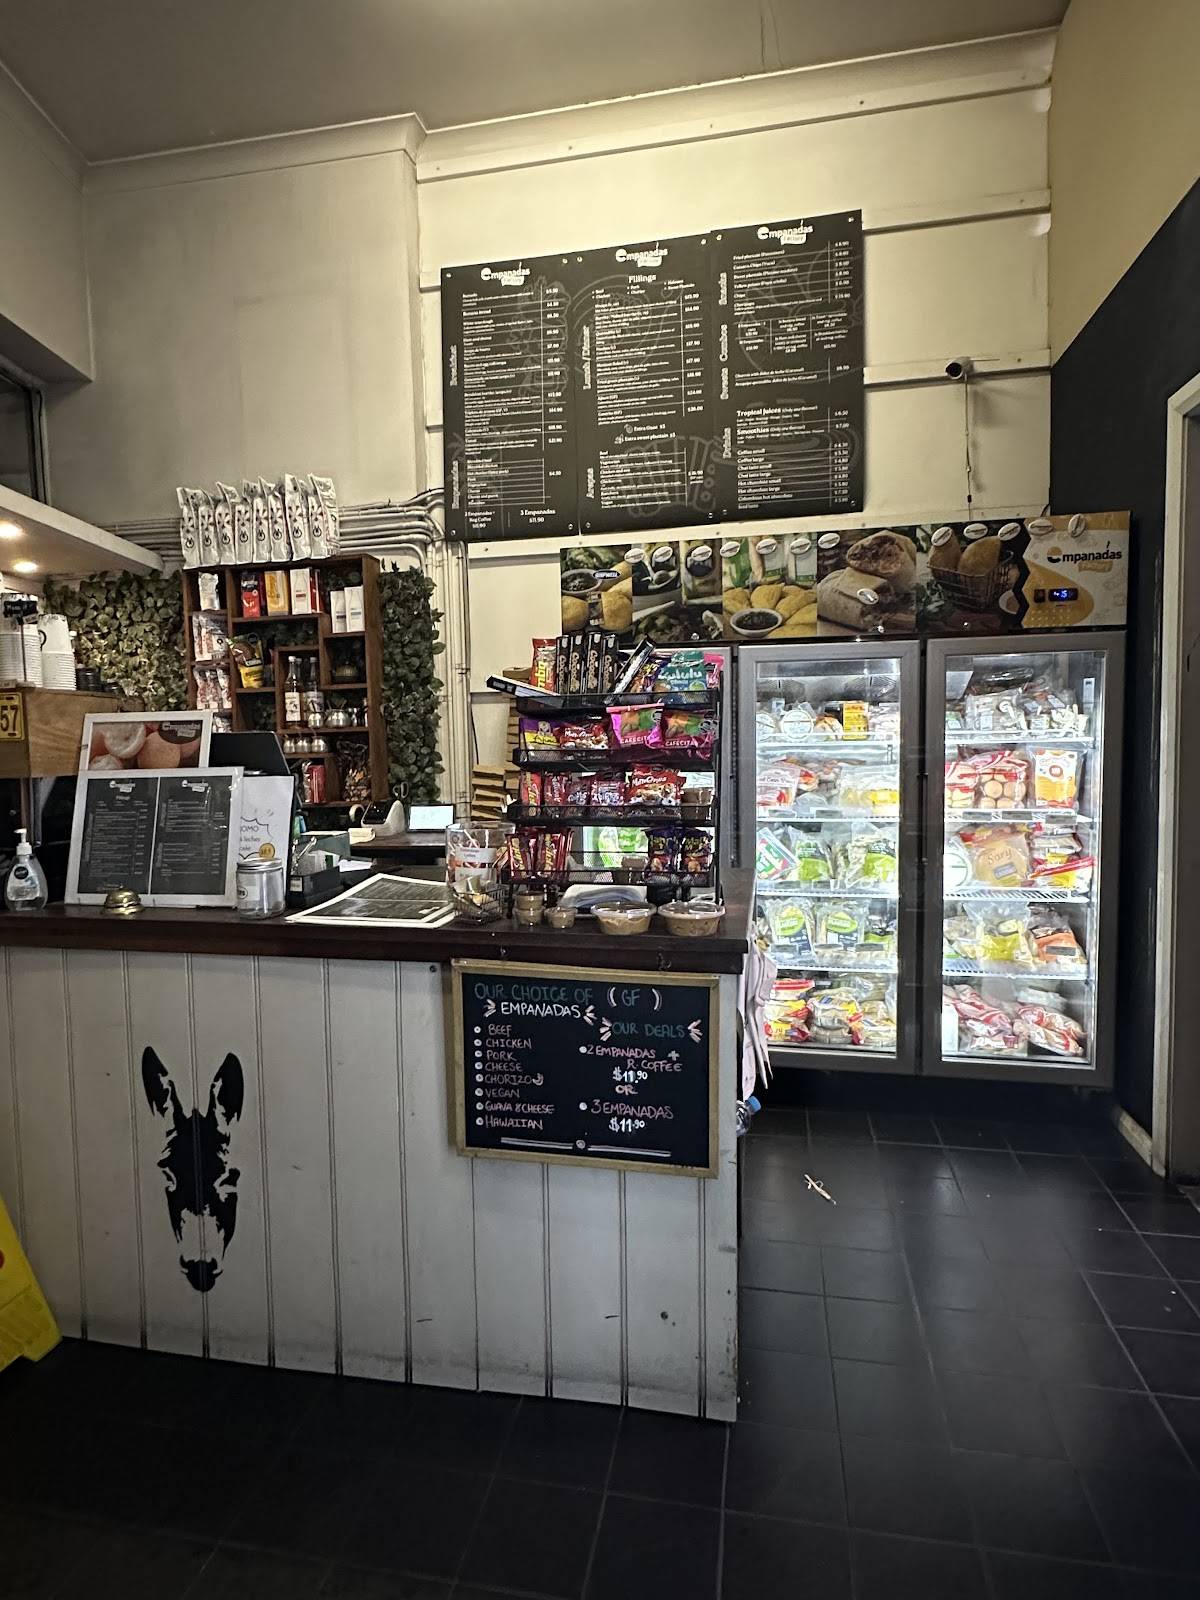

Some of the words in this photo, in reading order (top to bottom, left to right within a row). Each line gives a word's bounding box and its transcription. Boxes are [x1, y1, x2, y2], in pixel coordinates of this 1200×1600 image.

[628, 275, 657, 283] Fillings
[737, 409, 762, 417] Tropical
[737, 428, 769, 436] Smoothies
[474, 983, 504, 1000] OUR
[511, 985, 568, 1001] CHOICE
[574, 988, 593, 1004] OF
[621, 988, 641, 1006] GF
[501, 1002, 581, 1018] EMPANADAS
[488, 1025, 512, 1036] BEEF
[612, 1023, 638, 1035] OUR
[645, 1025, 685, 1038] DEALS
[486, 1037, 532, 1049] CHICKEN
[486, 1051, 517, 1061] PORK
[587, 1044, 594, 1055] 2
[595, 1046, 656, 1058] EMPANADAS
[485, 1061, 523, 1072] CHEESE
[642, 1060, 682, 1072] COFFEE
[485, 1074, 531, 1085] CHORIZO
[485, 1088, 520, 1098] VEGAN
[615, 1084, 638, 1095] OR
[485, 1101, 512, 1112] GUAVA
[591, 1099, 601, 1113] 3
[603, 1101, 674, 1120] EMPANADAS
[485, 1112, 543, 1129] HAWAIIAN
